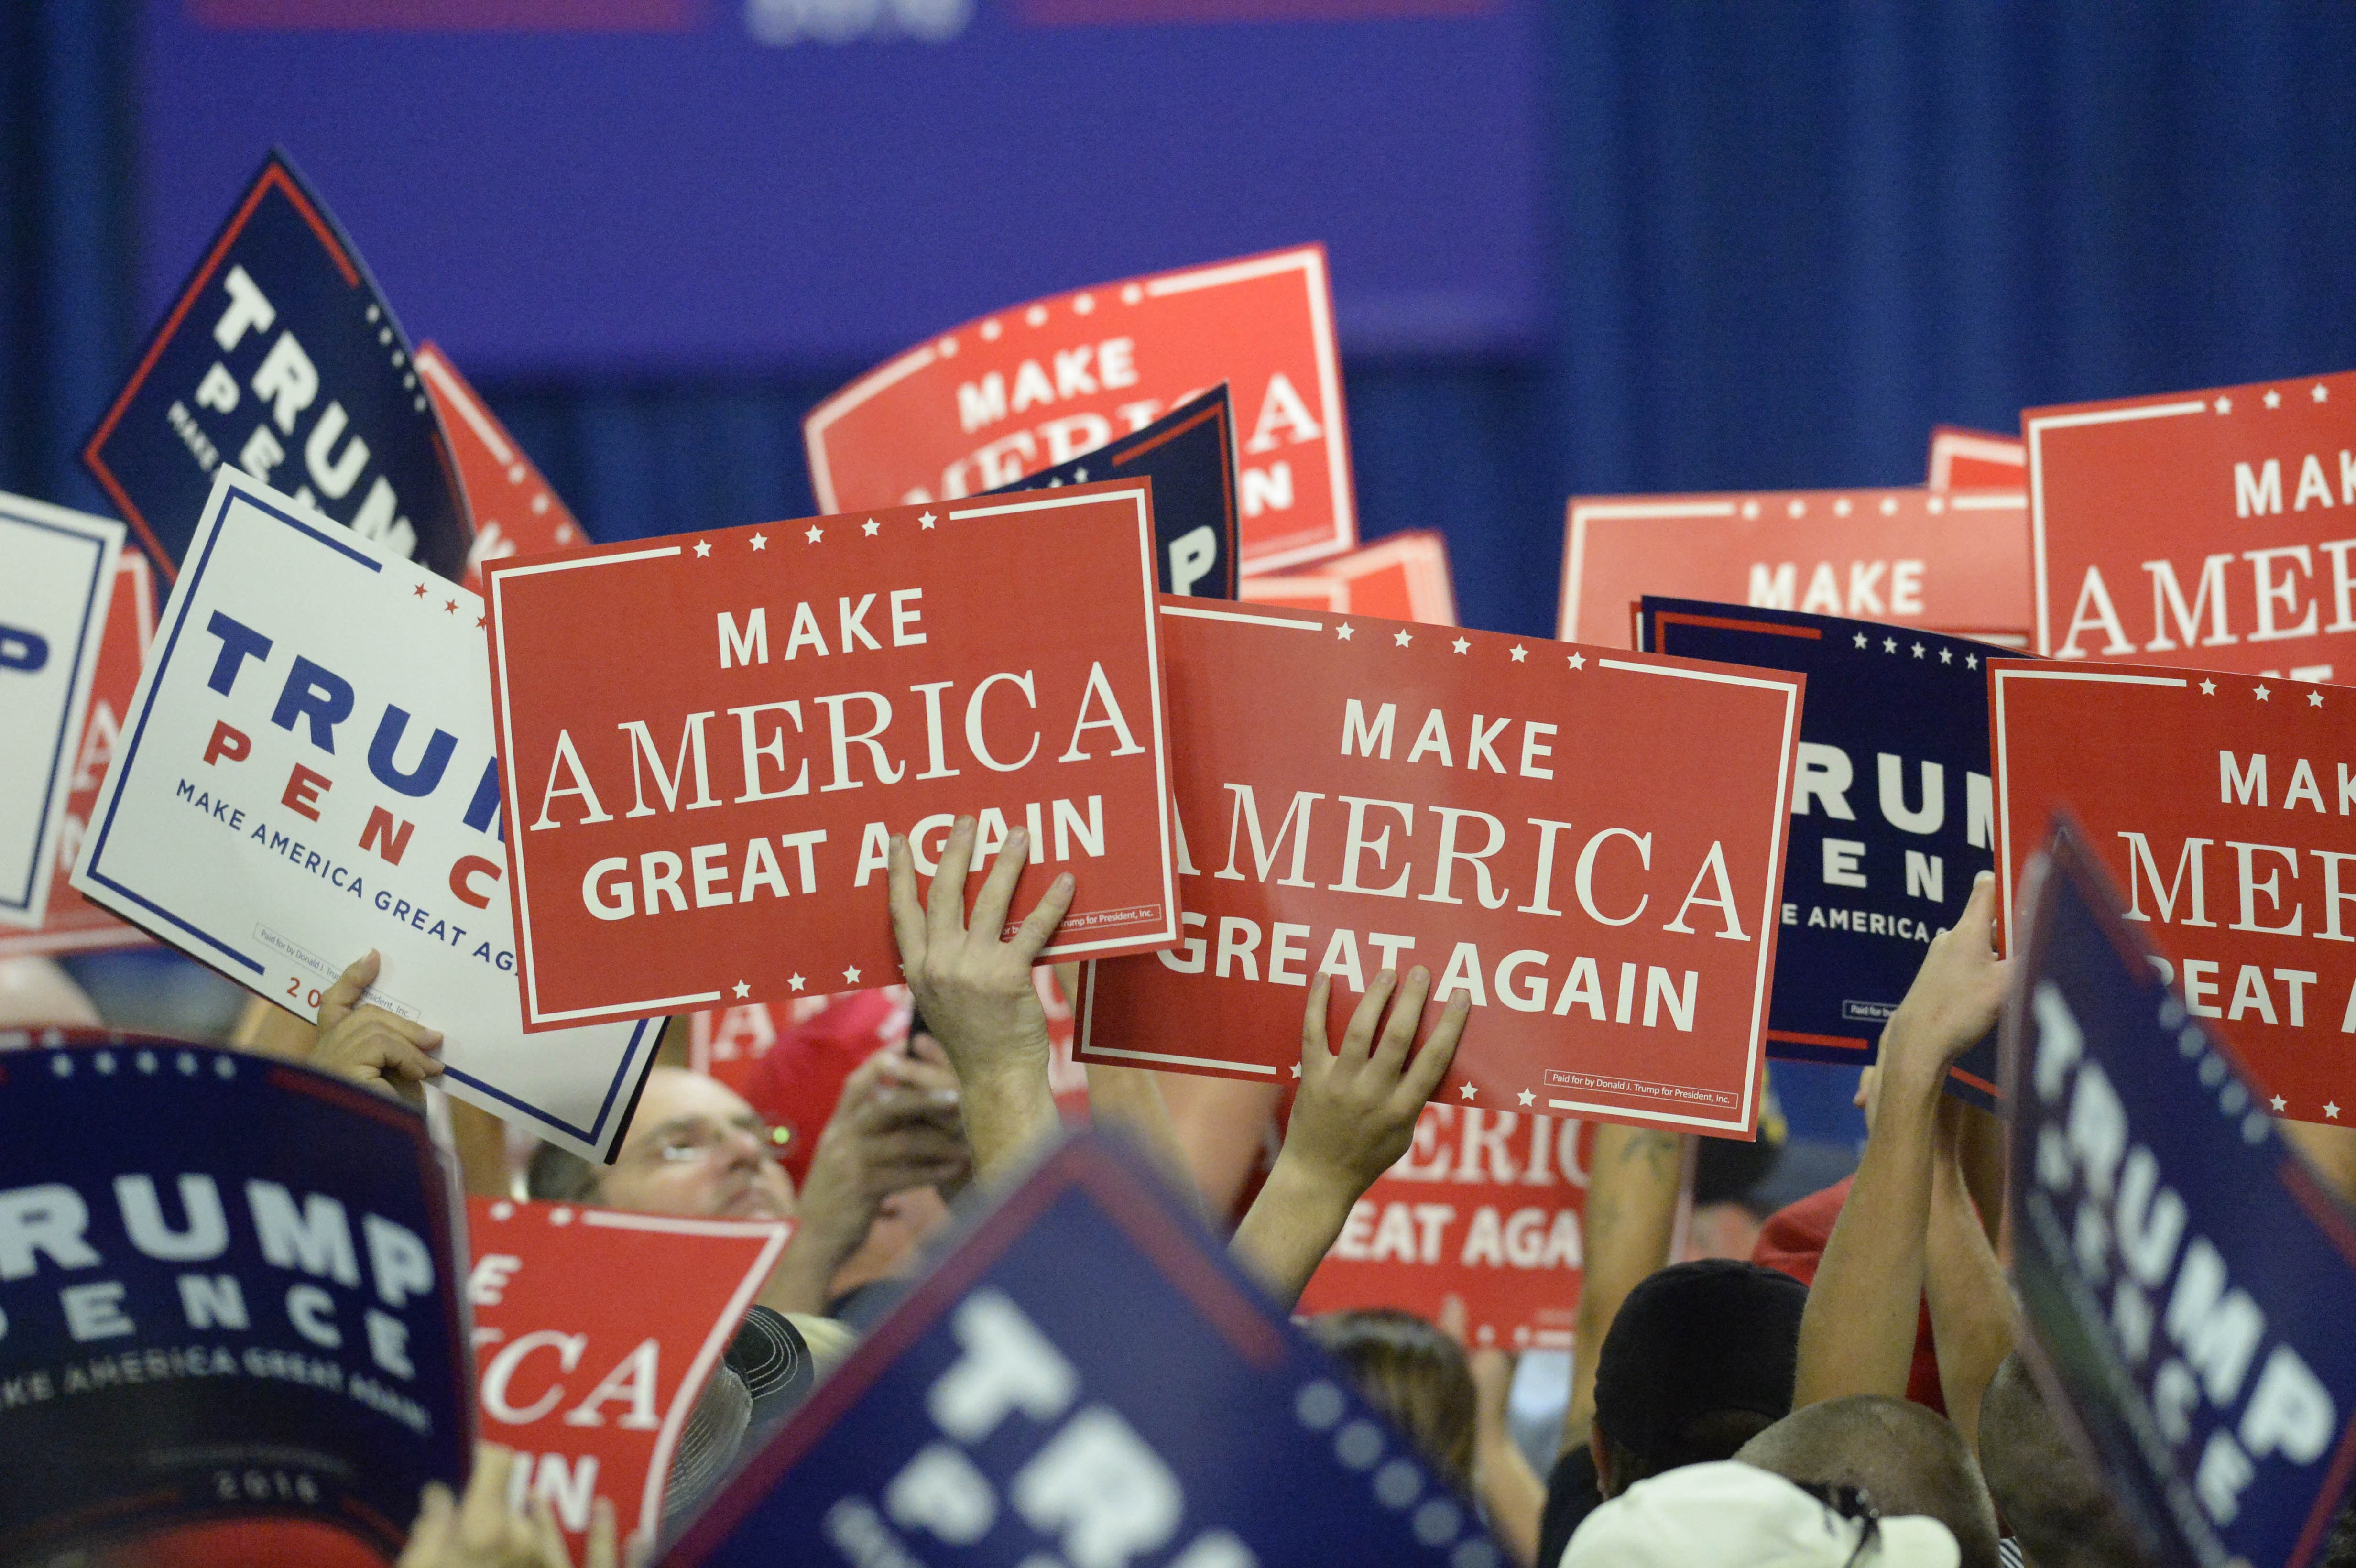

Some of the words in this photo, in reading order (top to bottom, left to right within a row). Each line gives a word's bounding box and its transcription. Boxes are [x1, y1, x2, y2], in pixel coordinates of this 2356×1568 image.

[213, 263, 429, 569] TRUM
[957, 337, 1139, 433] MAKE
[717, 588, 927, 668] MAKE
[1747, 559, 1926, 618] MAKE
[530, 661, 1145, 831] AMERICA
[1341, 699, 1558, 780] MAKE
[203, 719, 502, 909] PENC
[582, 829, 827, 921] GREAT
[854, 795, 1105, 888] AGAIN
[176, 779, 246, 830] MAKE
[251, 824, 362, 898] AMERICA
[375, 891, 467, 946] GREAT
[473, 942, 518, 976] AG
[1086, 915, 1097, 924] for
[1099, 911, 1138, 923] President,
[1139, 908, 1154, 918] Inc.
[1808, 906, 1930, 944] AMERICA
[261, 930, 275, 944] Paid
[276, 937, 286, 949] for
[286, 944, 296, 957] by
[296, 950, 320, 971] Donald
[395, 1004, 410, 1019] Inc.
[287, 977, 321, 1009] 20
[1156, 911, 1415, 993] GREAT
[1433, 942, 1699, 1033] AGAIN
[2147, 955, 2317, 1027] EAT
[1553, 1073, 1570, 1083] Paid
[1571, 1075, 1584, 1084] for
[1585, 1077, 1595, 1087] by
[1596, 1079, 1625, 1090] Donald
[1625, 1082, 1632, 1091] J.
[1634, 1084, 1660, 1095] Trump
[1661, 1087, 1673, 1096] for
[1675, 1089, 1713, 1103] President,
[1716, 1094, 1730, 1104] Inc.
[0, 1273, 418, 1380] ENCE
